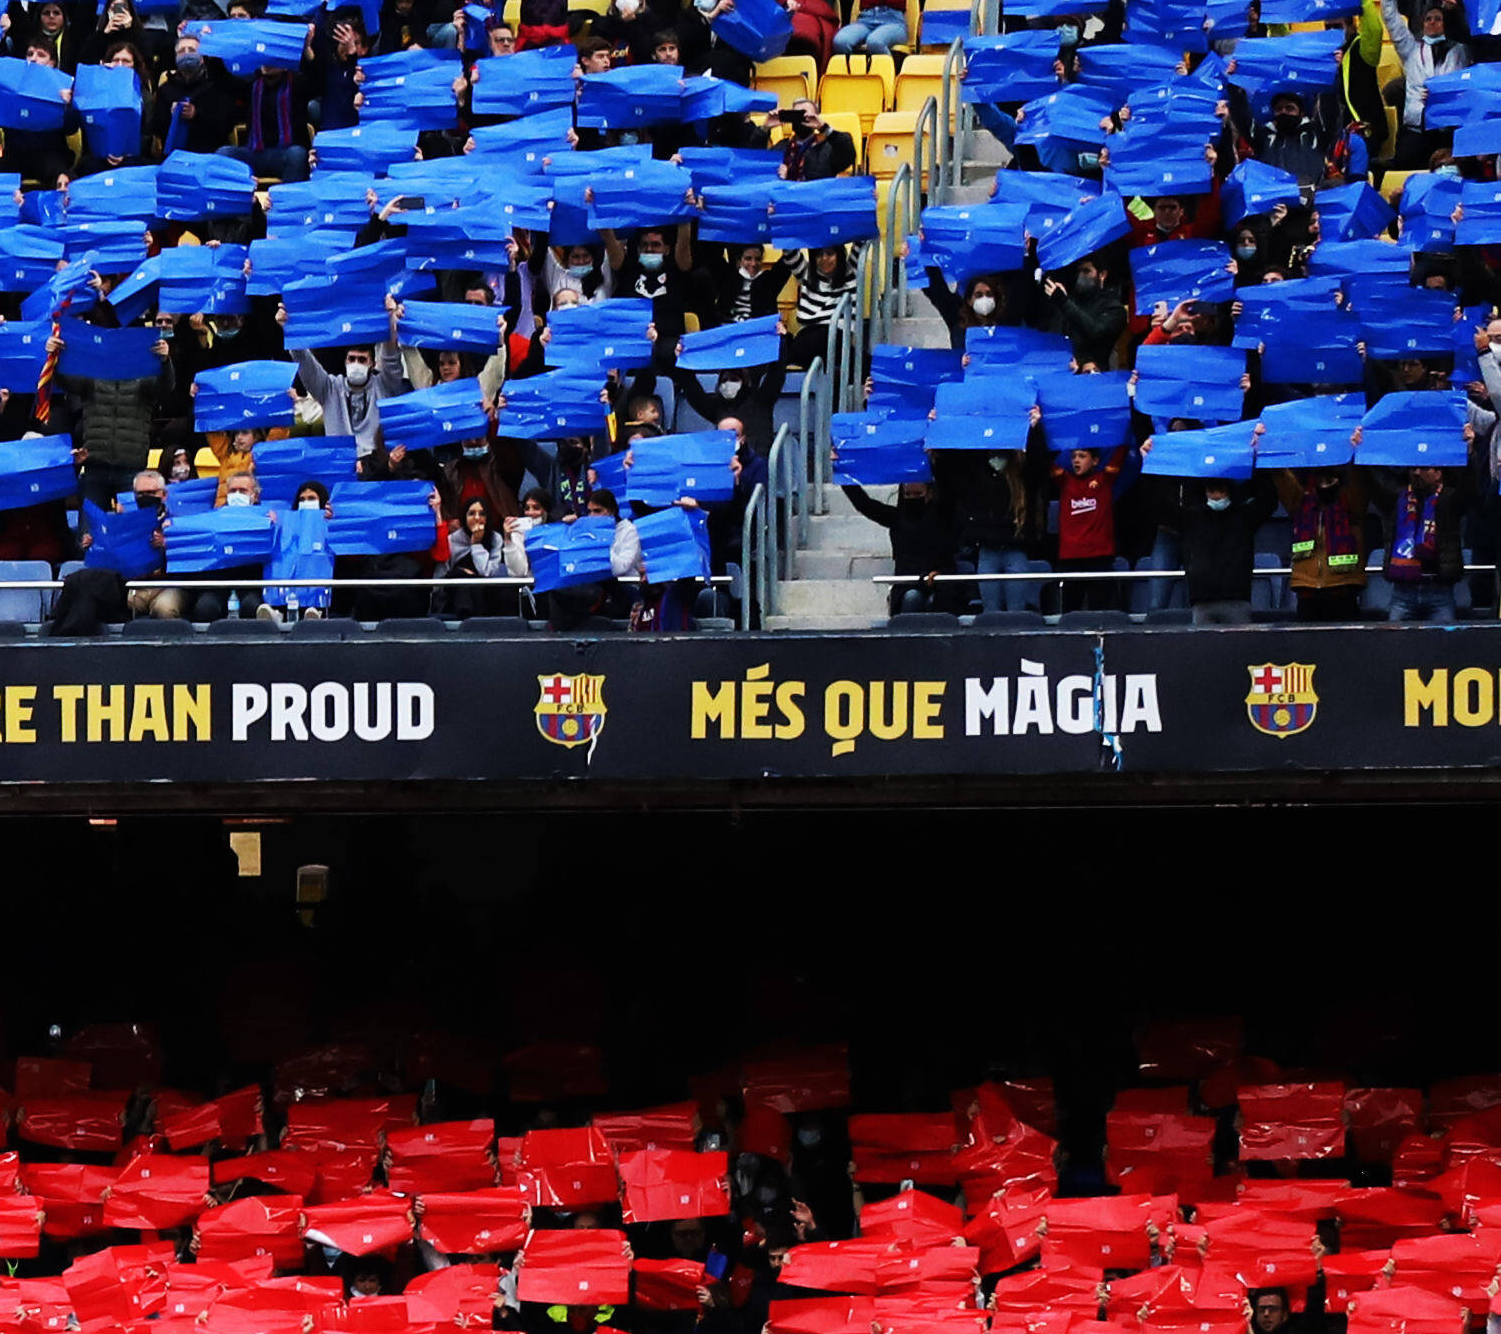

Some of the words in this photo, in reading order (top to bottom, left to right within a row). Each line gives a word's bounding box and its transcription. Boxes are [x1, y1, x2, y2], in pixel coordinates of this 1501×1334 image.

[1071, 497, 1097, 509] beko
[54, 683, 211, 742] THAN
[233, 682, 435, 742] PROUD
[692, 664, 805, 740] MÉS
[825, 680, 946, 757] QUE
[965, 658, 1162, 735] MÀGIA
[1403, 667, 1501, 727] MO
